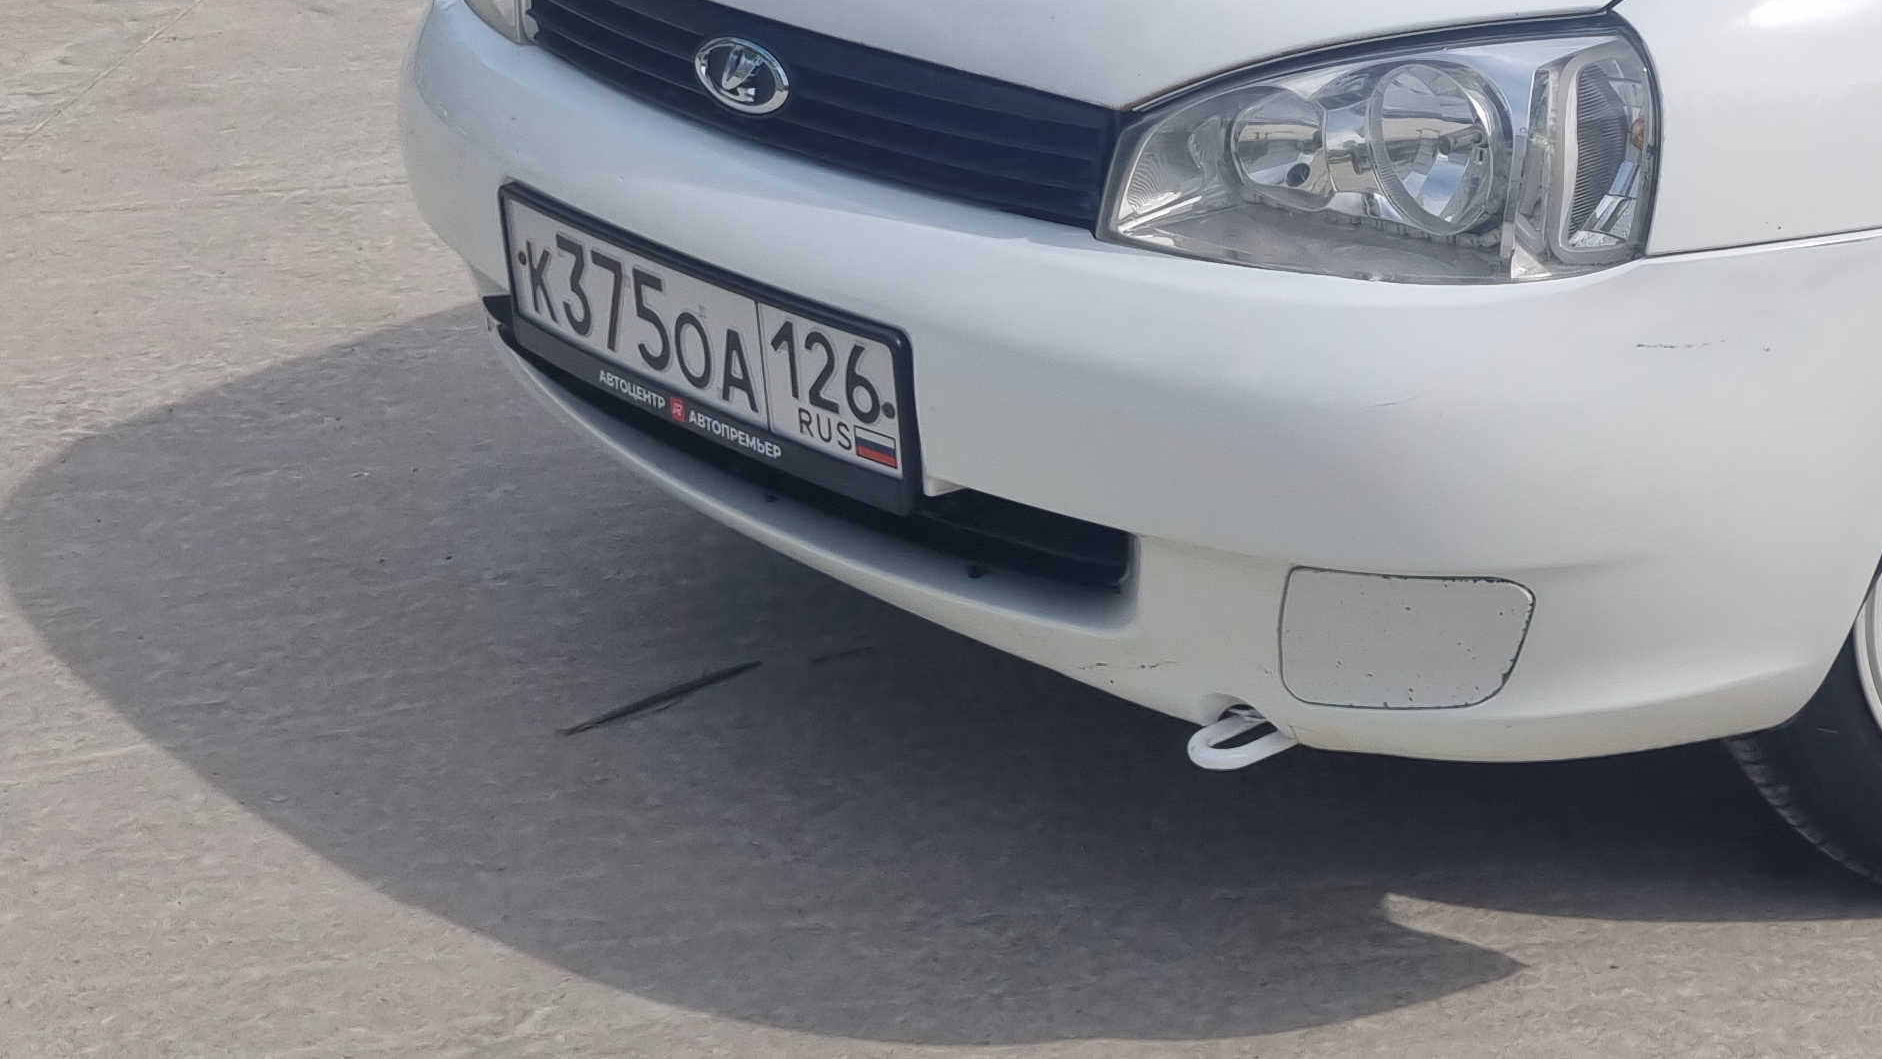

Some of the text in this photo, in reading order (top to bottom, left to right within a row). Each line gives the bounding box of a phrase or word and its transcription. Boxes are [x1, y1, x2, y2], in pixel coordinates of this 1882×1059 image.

[599, 369, 782, 460] АВТОЦЕНТР АВТОПРЕМЬЕР
[770, 320, 882, 425] 126
[797, 407, 853, 452] RUS
